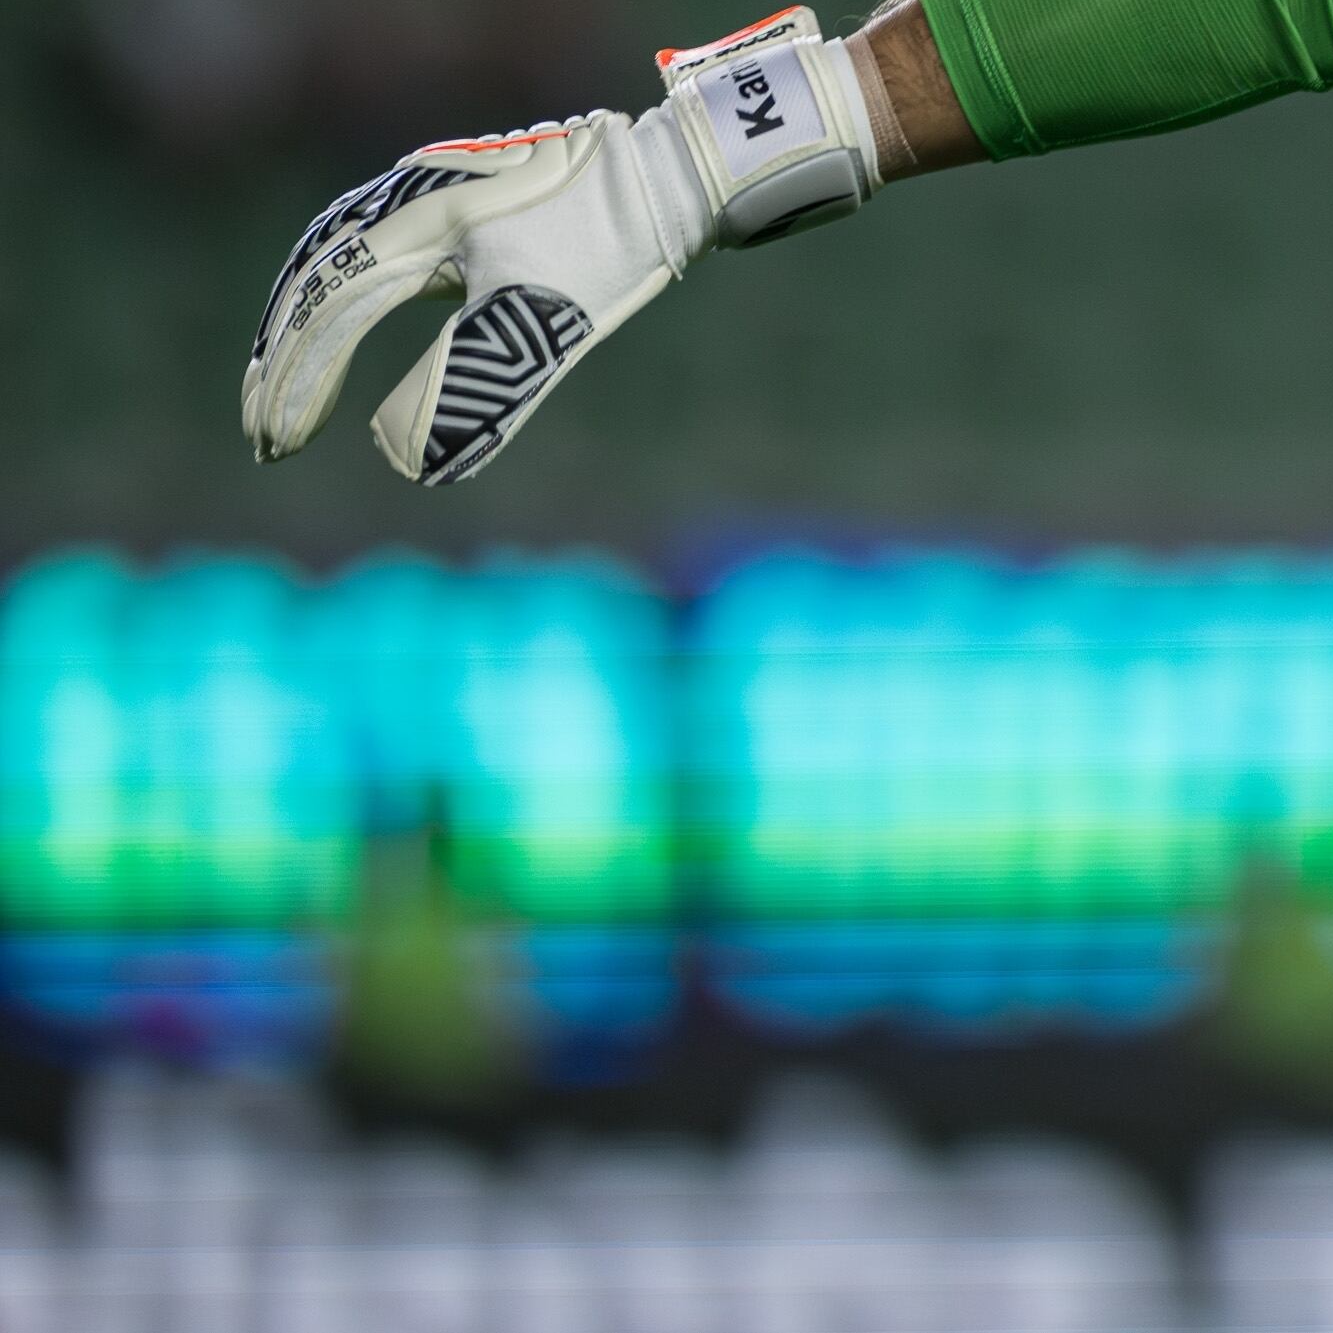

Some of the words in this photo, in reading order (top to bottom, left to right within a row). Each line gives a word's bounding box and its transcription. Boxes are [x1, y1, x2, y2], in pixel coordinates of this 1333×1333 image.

[720, 59, 785, 140] Kari
[331, 237, 371, 272] HO
[344, 255, 377, 280] PRO
[292, 276, 343, 331] CURVED
